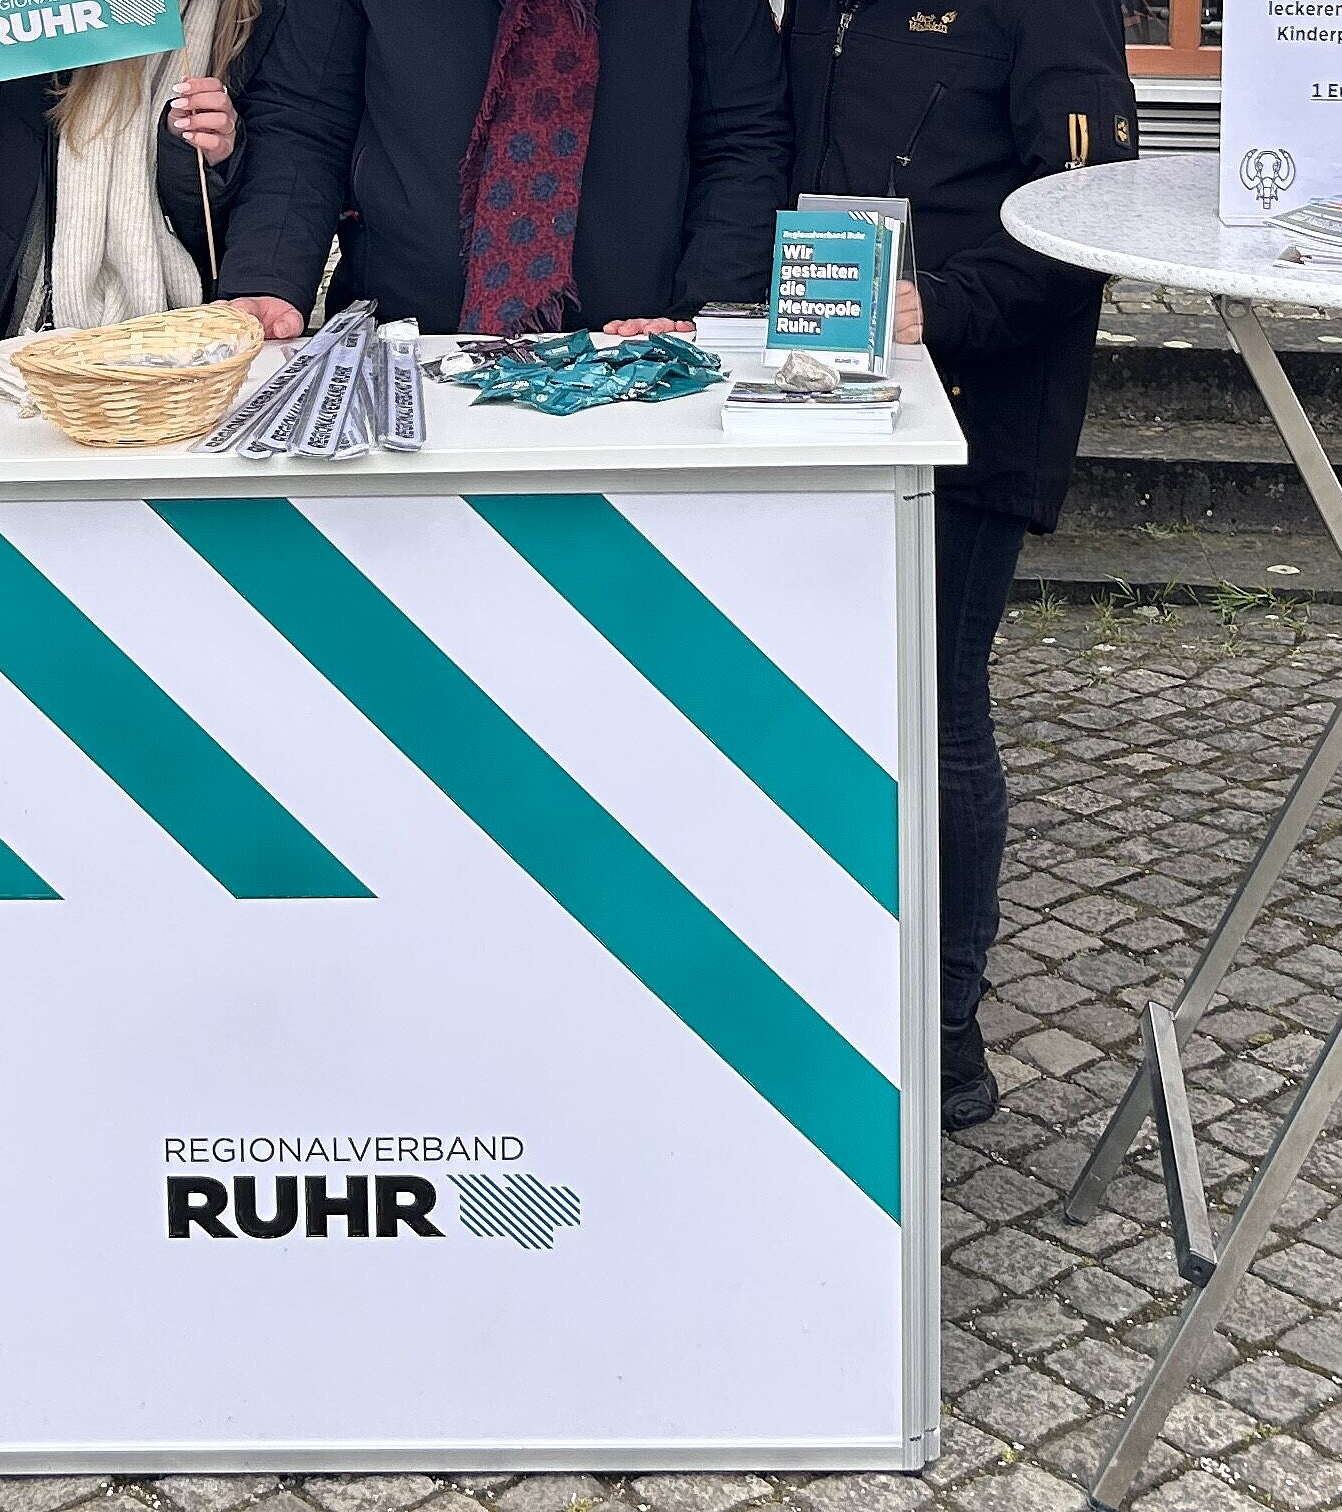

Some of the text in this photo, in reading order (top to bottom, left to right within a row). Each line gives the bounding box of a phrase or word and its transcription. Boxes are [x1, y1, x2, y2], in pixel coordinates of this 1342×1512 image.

[1312, 83, 1322, 98] 1
[782, 244, 813, 260] Wir
[781, 264, 859, 280] gestalten
[779, 281, 805, 296] die
[778, 299, 861, 318] Metropole
[777, 318, 821, 334] Ruhr.
[165, 1136, 524, 1162] REGIONALVERBAND
[167, 1175, 446, 1239] RUHR
